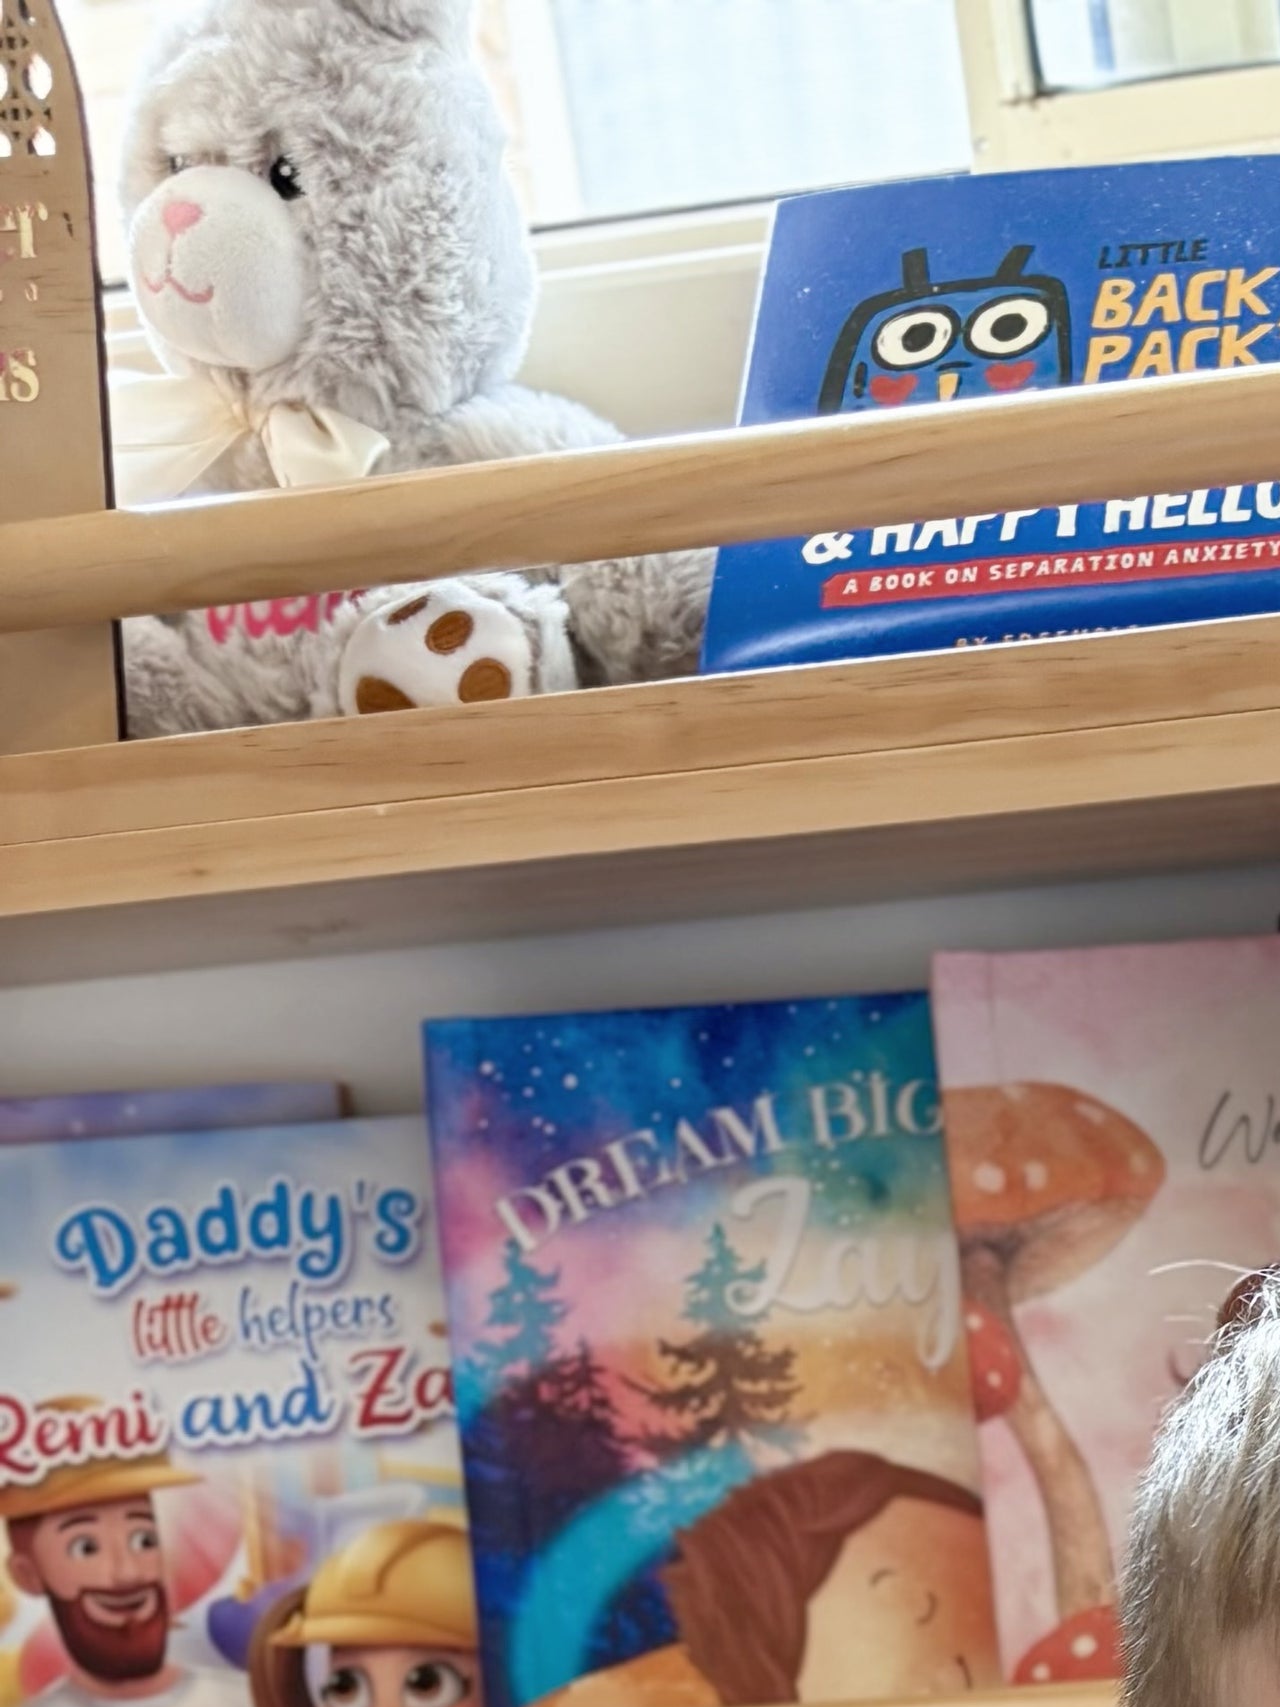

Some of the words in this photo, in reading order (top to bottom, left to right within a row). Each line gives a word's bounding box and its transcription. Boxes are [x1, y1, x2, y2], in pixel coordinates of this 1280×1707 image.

[1098, 238, 1209, 269] LITTLE
[802, 531, 855, 565] &
[843, 577, 859, 595] A
[869, 570, 936, 593] BOOK
[945, 566, 978, 585] ON
[989, 549, 1154, 580] SEPARATION
[495, 1091, 786, 1254] DREAM
[55, 1180, 417, 1288] Daddy's
[133, 1290, 224, 1358] little
[239, 1281, 395, 1362] helpers
[181, 1362, 331, 1439] and
